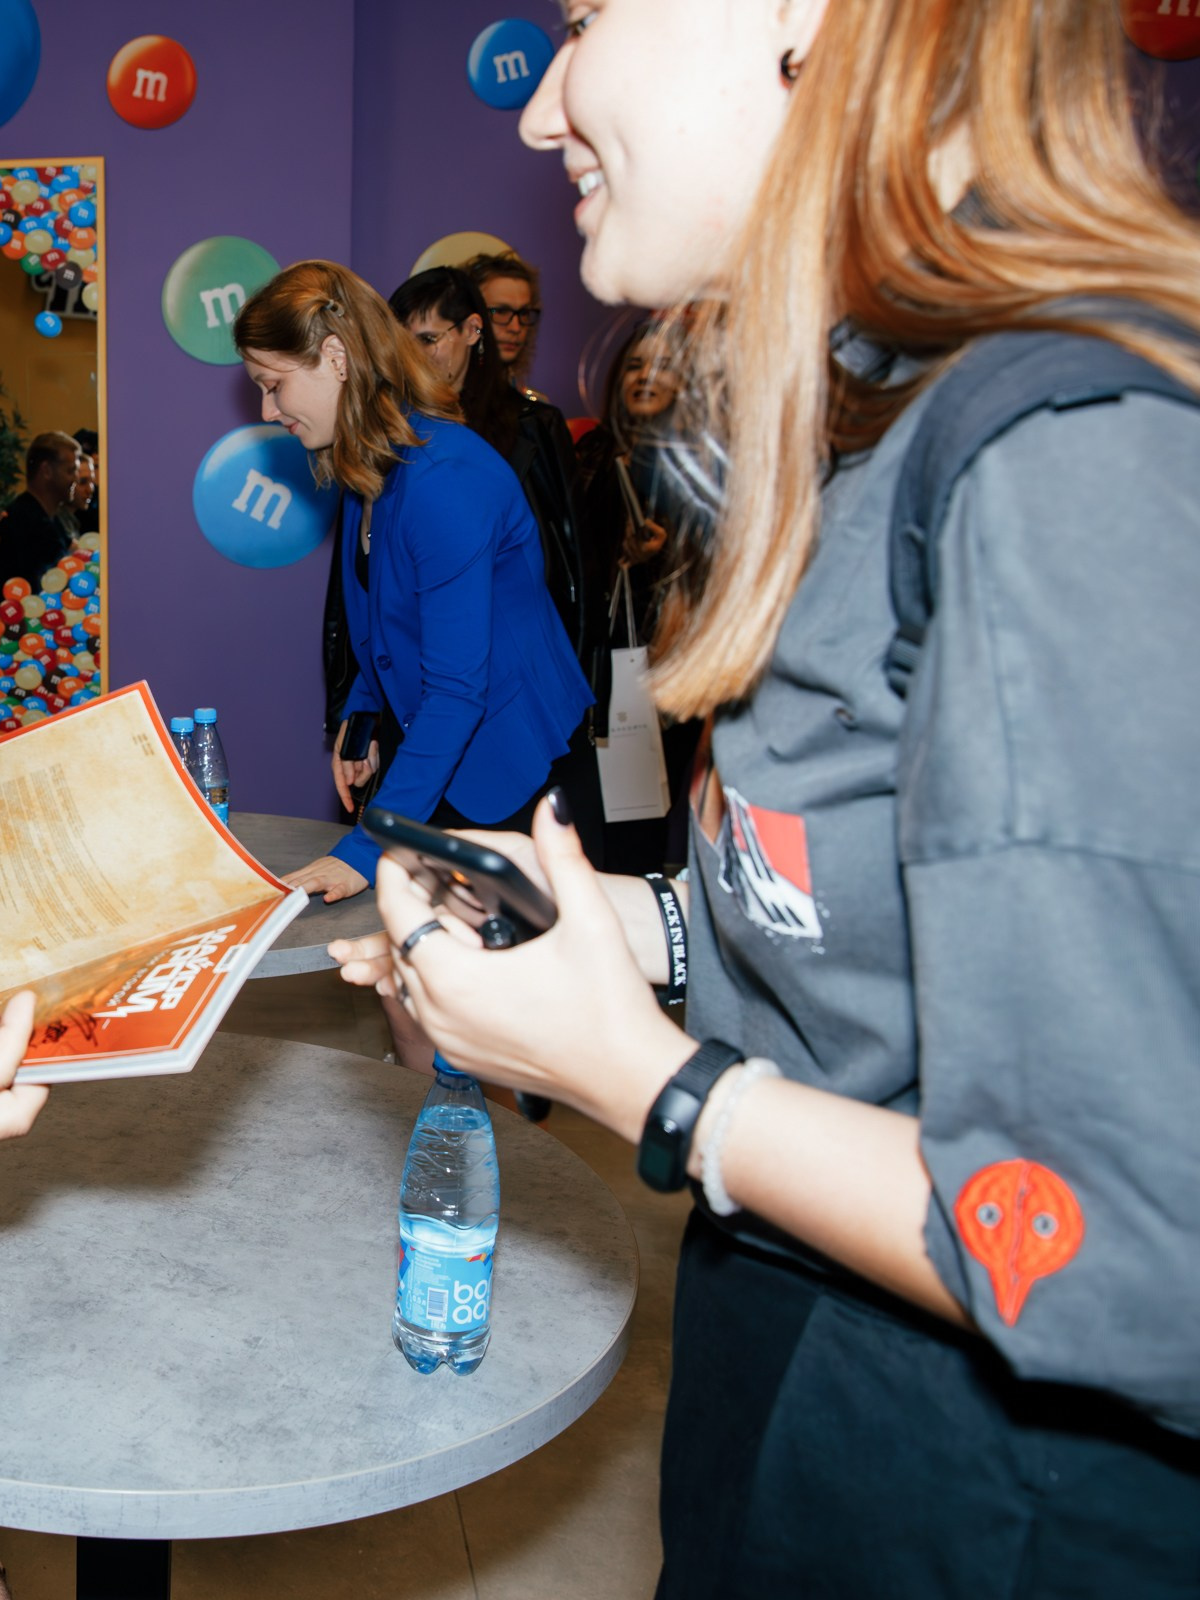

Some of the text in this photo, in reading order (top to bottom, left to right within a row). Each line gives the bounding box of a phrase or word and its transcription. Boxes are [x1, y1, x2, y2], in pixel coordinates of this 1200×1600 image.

[492, 49, 530, 84] m
[132, 68, 169, 102] m
[231, 469, 293, 531] m
[670, 925, 684, 944] IN
